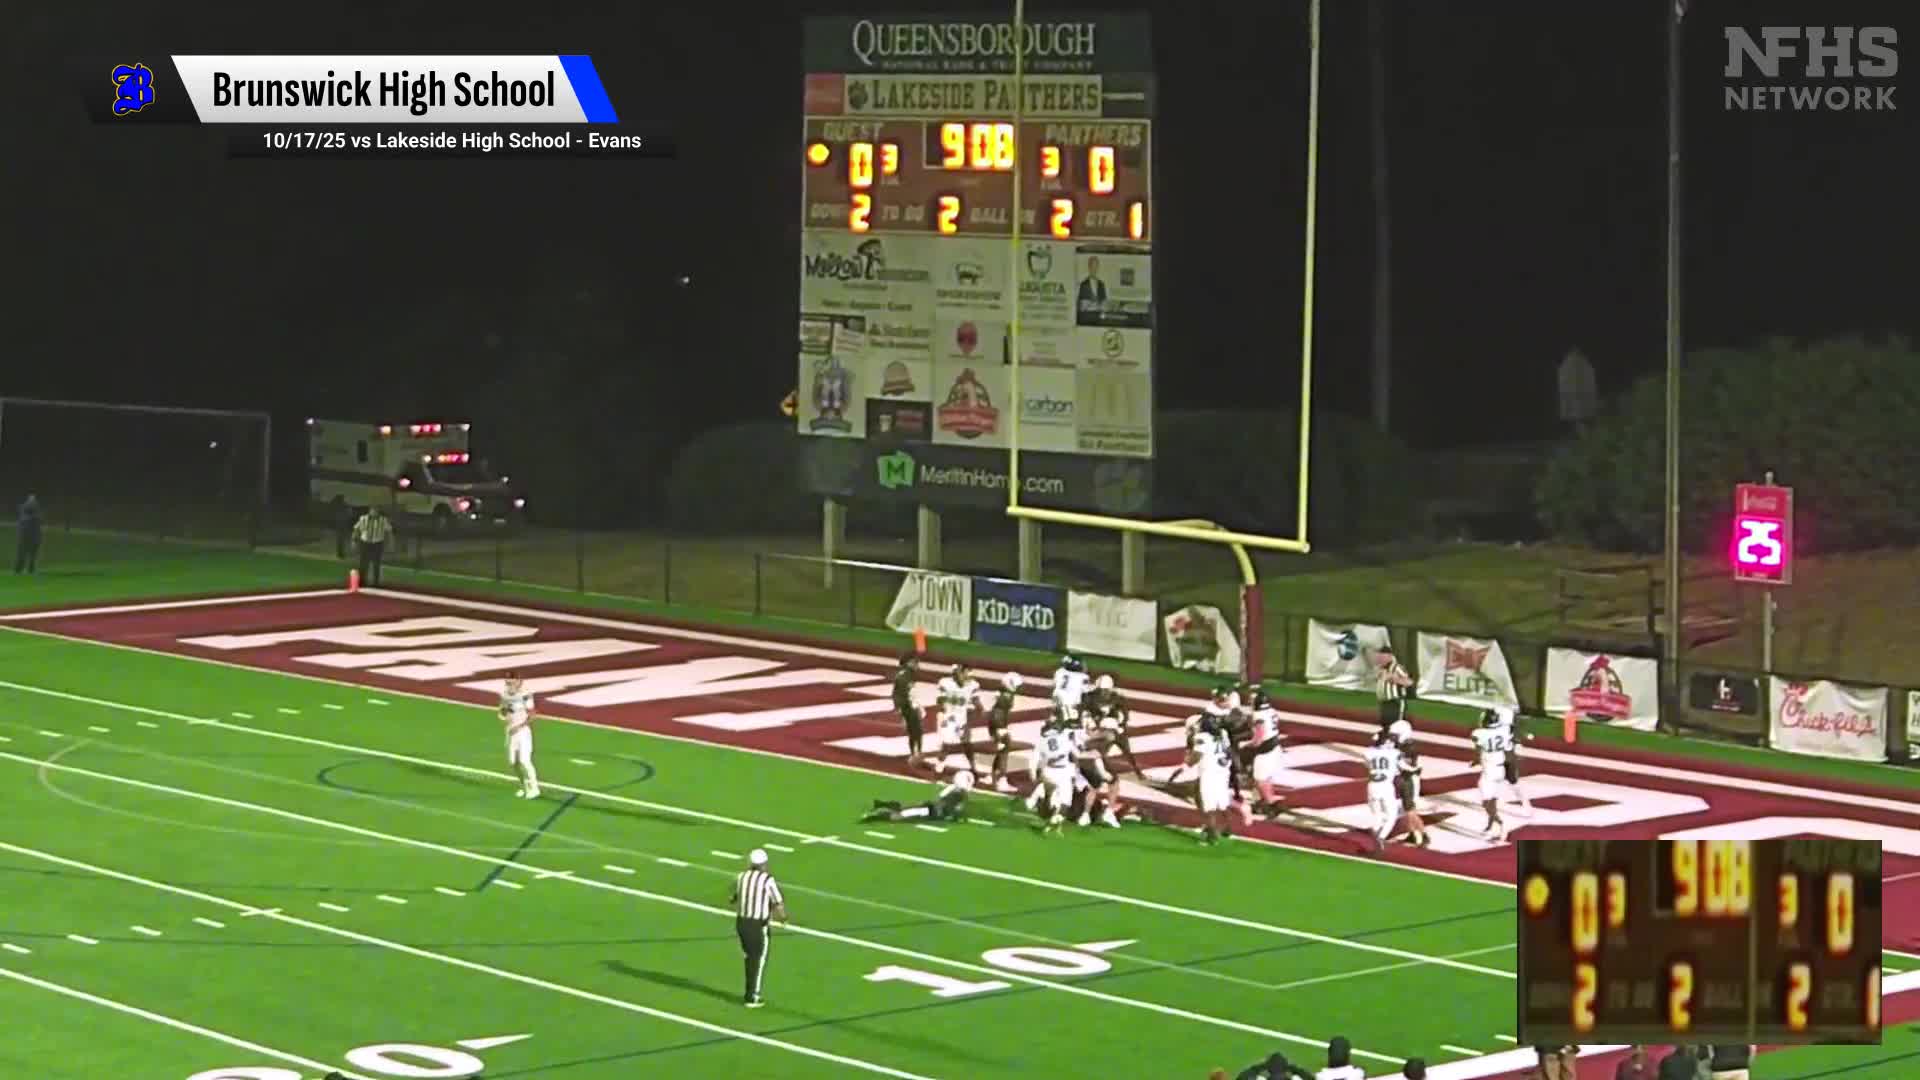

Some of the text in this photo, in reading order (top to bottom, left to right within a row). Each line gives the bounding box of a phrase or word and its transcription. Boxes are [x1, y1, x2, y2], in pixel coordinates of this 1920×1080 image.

[852, 20, 1096, 66] QUEENSBOROUGH
[871, 80, 975, 110] LAKESIDE
[849, 143, 873, 188] 0
[880, 143, 898, 175] 3
[1041, 146, 1060, 178] 3
[1088, 146, 1115, 194] 0
[850, 193, 871, 234] 2
[938, 196, 960, 235] 2
[1051, 199, 1073, 240] 2
[1130, 202, 1143, 240] 1
[1739, 520, 1781, 566] 25
[1487, 735, 1504, 753] 12
[862, 946, 1112, 997] 10
